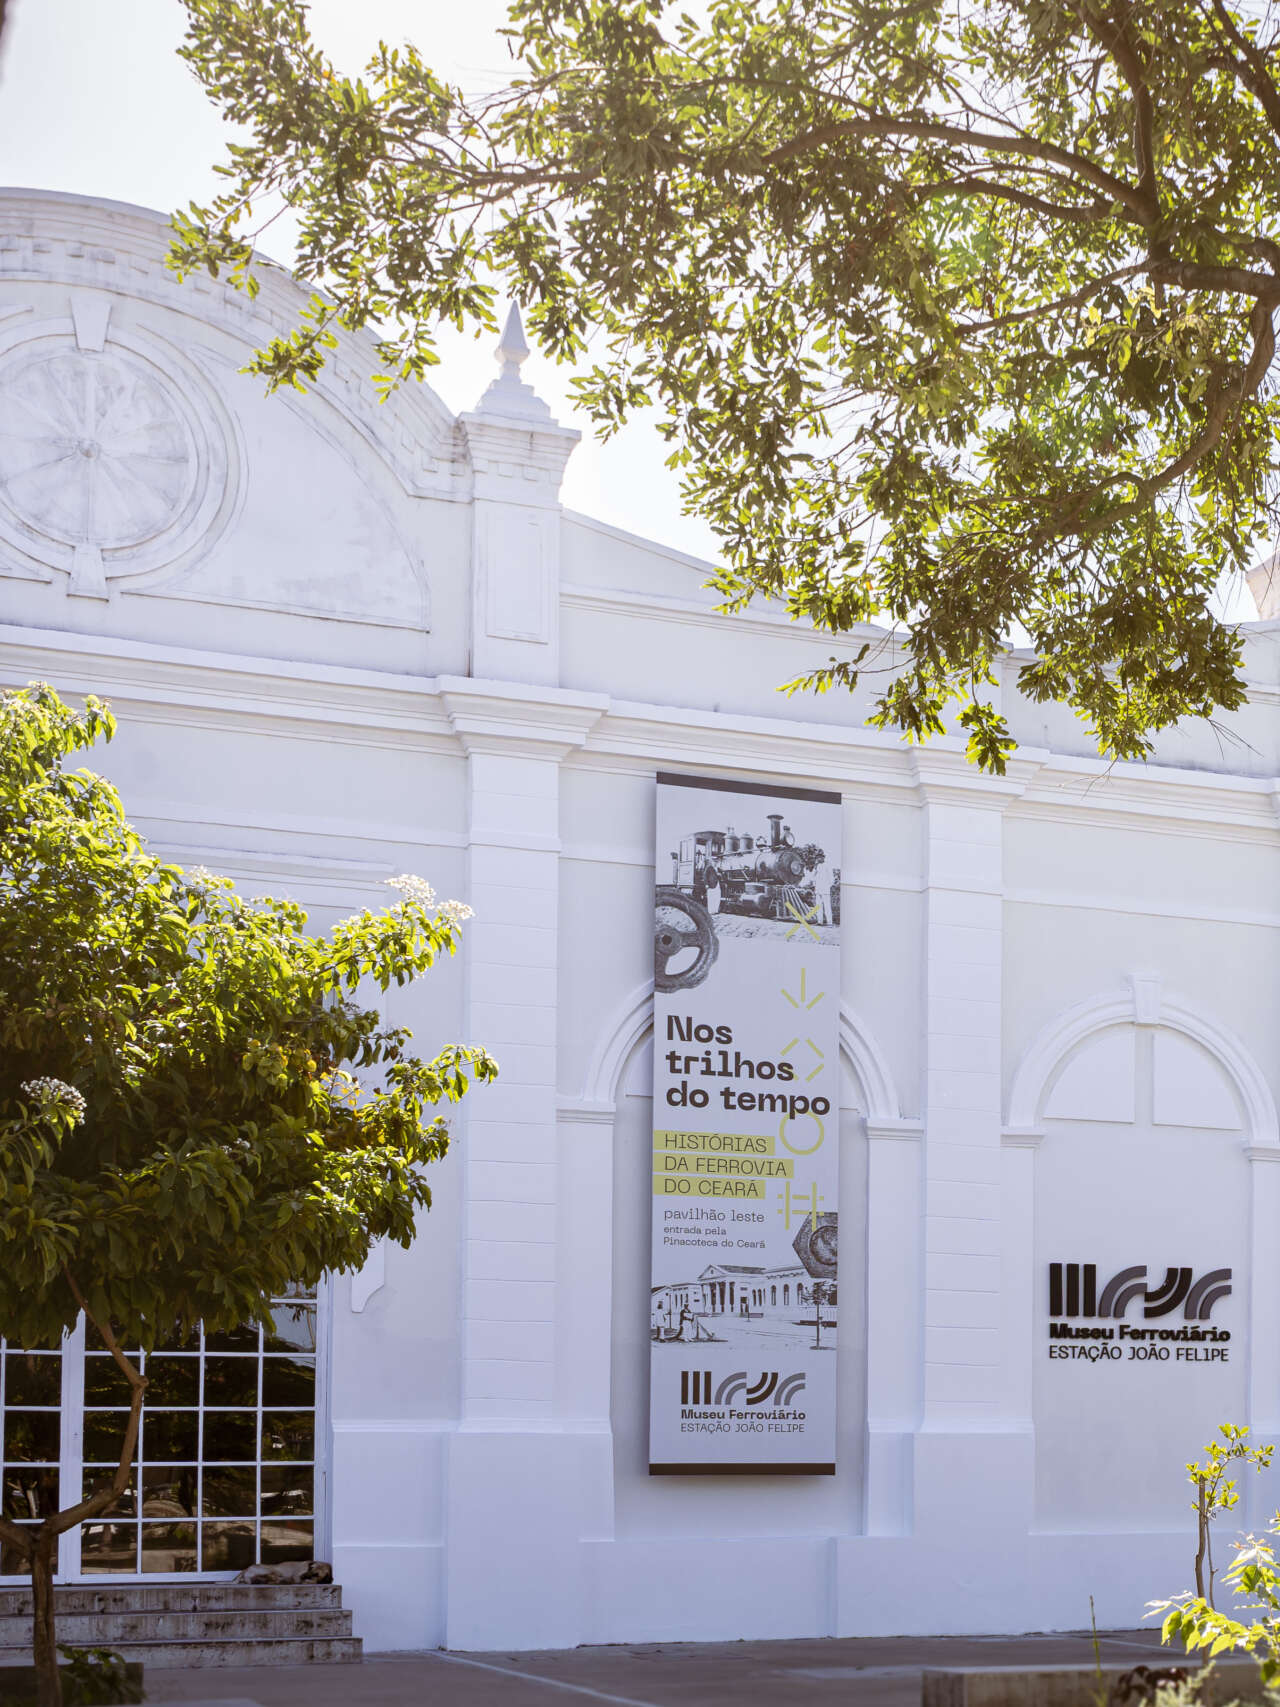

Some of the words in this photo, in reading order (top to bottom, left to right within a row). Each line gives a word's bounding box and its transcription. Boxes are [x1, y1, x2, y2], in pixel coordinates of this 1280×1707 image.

[666, 1015, 733, 1044] Nos
[665, 1050, 794, 1082] trilhos
[666, 1081, 709, 1108] do
[720, 1086, 830, 1120] tempo
[664, 1133, 767, 1153] HISTÓRIAS
[664, 1156, 689, 1172] DA
[695, 1158, 787, 1177] FERROVIA
[664, 1178, 691, 1194] DO
[698, 1178, 758, 1197] CEARÁ
[664, 1208, 726, 1221] pavilhão
[731, 1210, 765, 1222] leste
[663, 1226, 702, 1234] entrada
[705, 1227, 727, 1236] pela
[663, 1236, 718, 1247] Pinacoteca
[721, 1239, 734, 1248] do
[737, 1240, 766, 1248] Ceará
[1050, 1323, 1114, 1340] Museu
[1119, 1325, 1231, 1342] Ferroviário
[1050, 1343, 1122, 1363] ESTAÇÃO
[1127, 1344, 1170, 1361] JOÃO
[1176, 1348, 1229, 1362] FELIPE
[681, 1409, 726, 1420] Museu
[729, 1409, 805, 1421] Ferroviário
[680, 1420, 731, 1434] ESTAÇÃO
[734, 1421, 764, 1433] JOÃO
[768, 1423, 805, 1433] FELIPE
